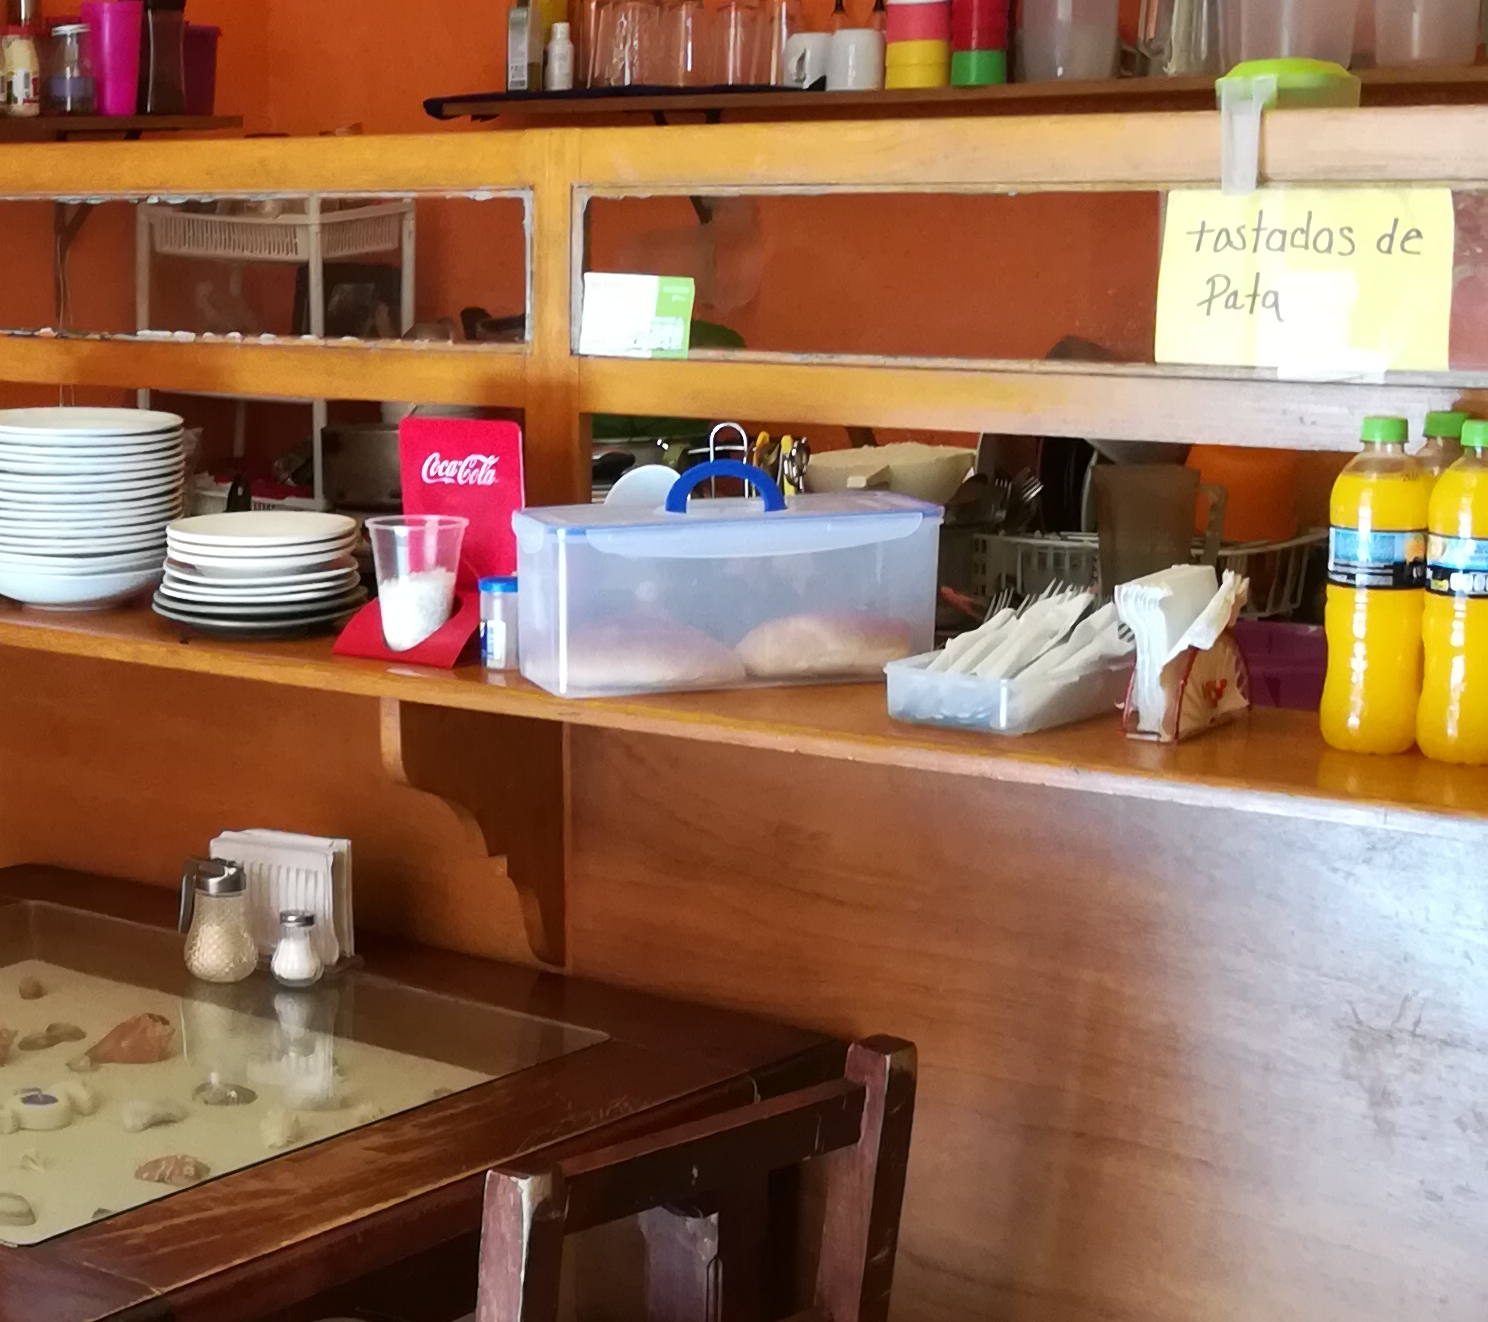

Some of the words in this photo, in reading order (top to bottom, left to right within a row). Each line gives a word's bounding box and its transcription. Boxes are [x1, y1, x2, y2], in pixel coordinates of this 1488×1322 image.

[1375, 217, 1424, 256] de
[1196, 271, 1284, 323] Pata
[421, 452, 499, 485] Coca-Cola
